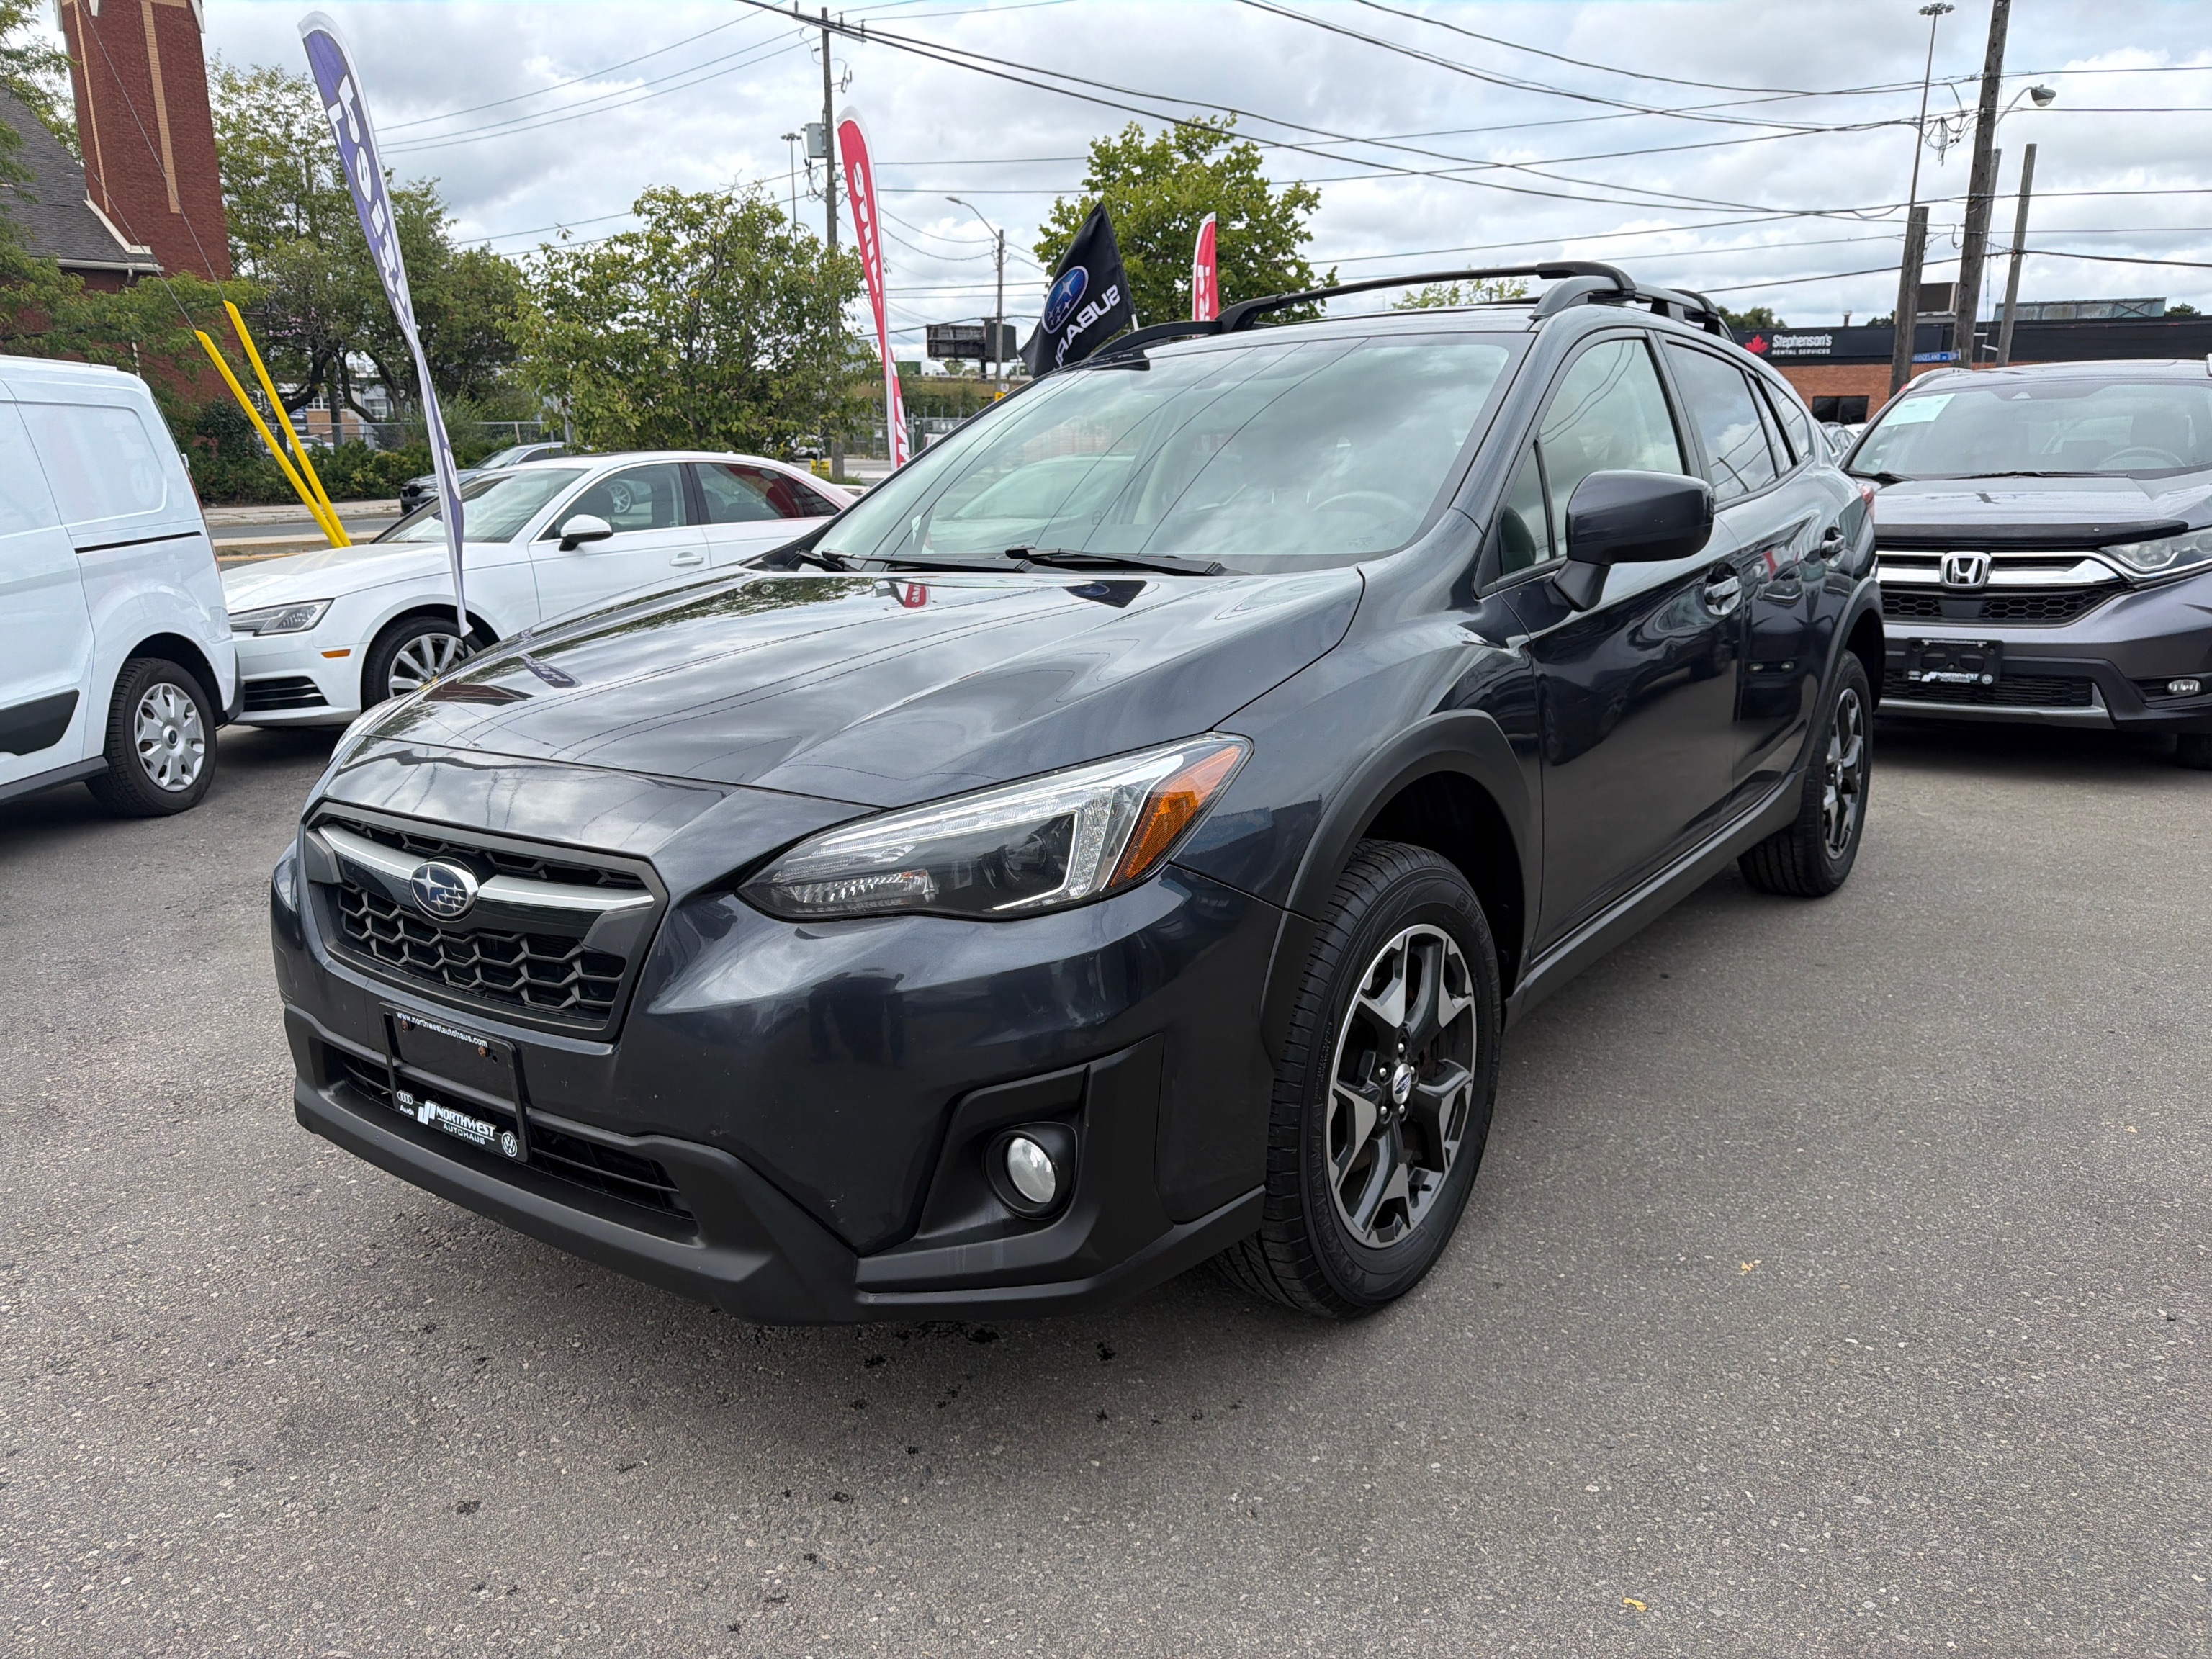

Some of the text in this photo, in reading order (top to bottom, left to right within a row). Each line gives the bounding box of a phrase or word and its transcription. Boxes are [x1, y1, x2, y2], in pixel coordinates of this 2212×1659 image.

[1772, 333, 1833, 348] Stephenson's
[1912, 353, 1941, 361] RIDGELAND
[396, 1012, 488, 1048] www.northwestautohaus.com
[436, 1105, 495, 1138] NORTHWEST
[443, 1123, 485, 1146] AUTOHAUS
